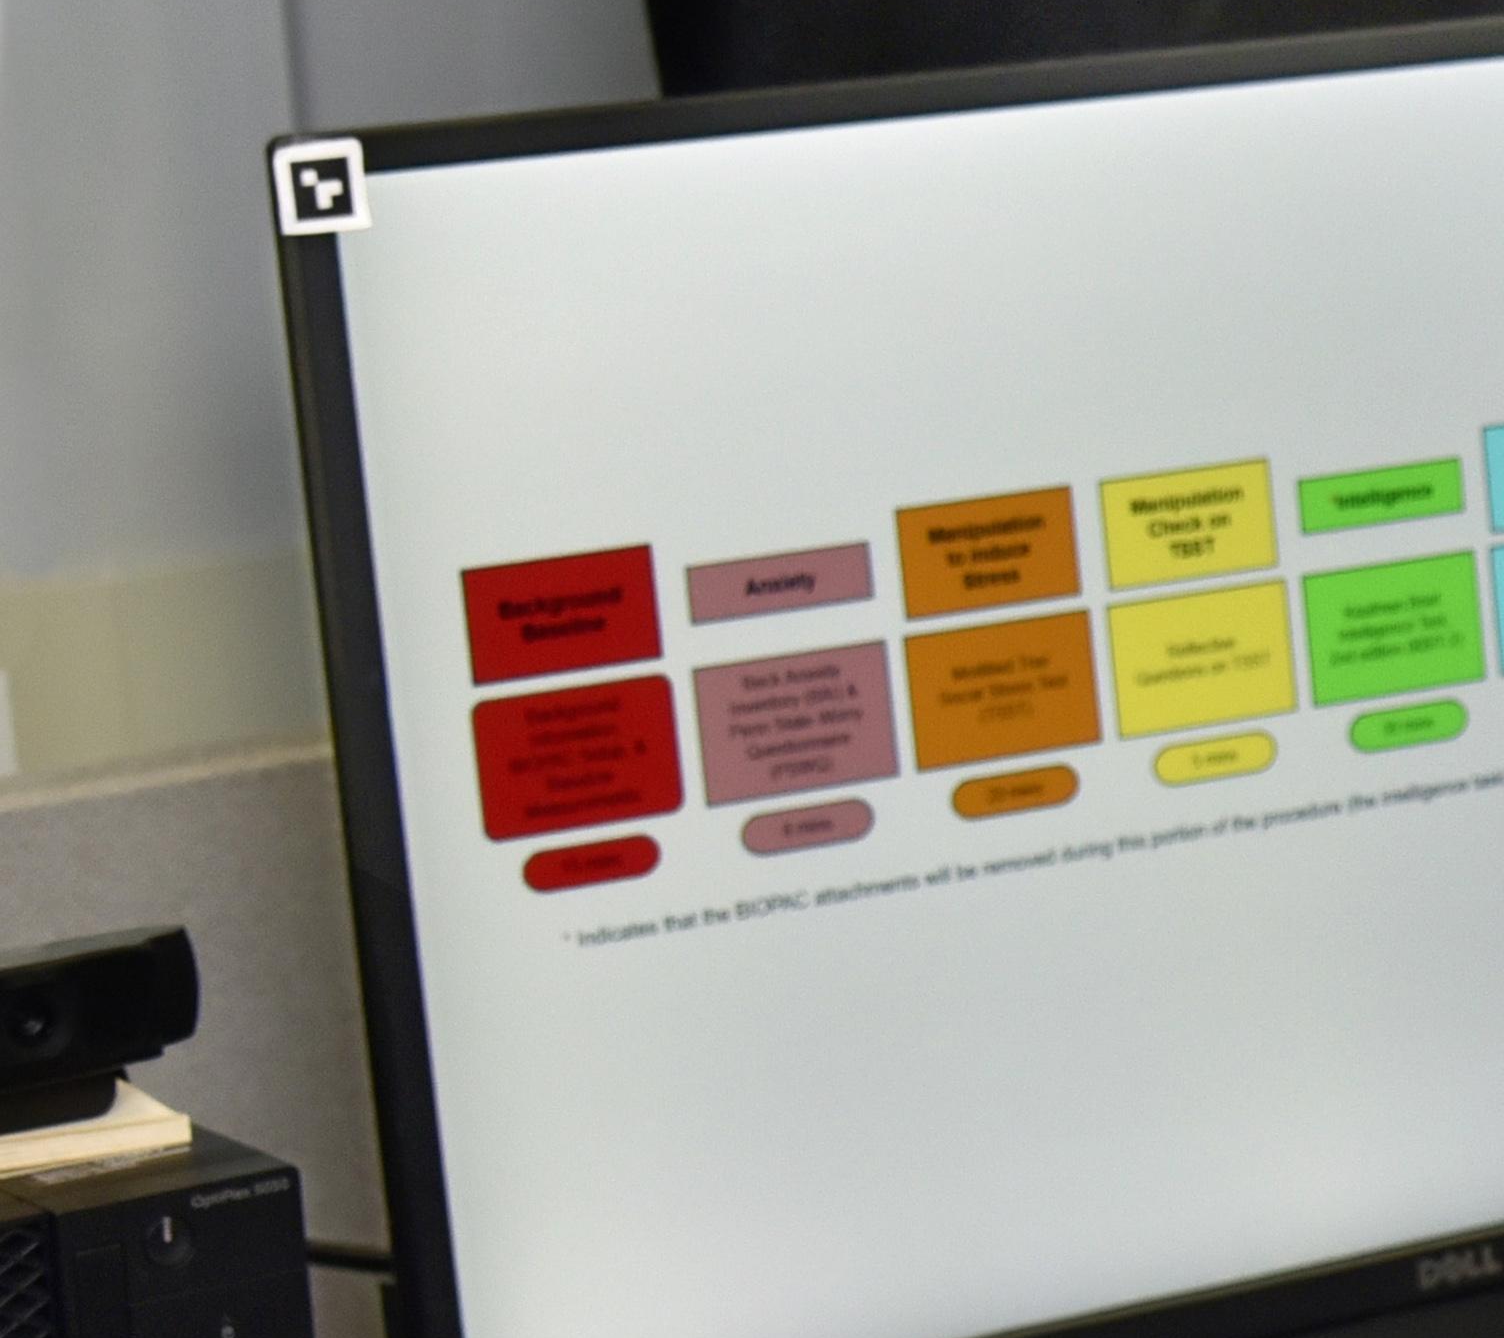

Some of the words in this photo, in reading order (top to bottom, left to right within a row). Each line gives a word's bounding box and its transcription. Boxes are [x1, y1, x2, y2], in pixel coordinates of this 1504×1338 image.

[1129, 486, 1243, 516] Manipulation
[927, 515, 1044, 544] Manipulation
[1147, 515, 1201, 538] Check
[1206, 510, 1232, 530] on
[745, 572, 817, 598] Anxiety
[964, 569, 1020, 590] Stress
[498, 586, 623, 619] Background
[728, 694, 801, 717] Inventory
[577, 919, 657, 948] Indicates
[662, 911, 697, 932] that
[701, 907, 731, 926] the
[734, 888, 810, 922] BIOPAC
[815, 873, 921, 907] attachments
[924, 863, 952, 886] will
[955, 861, 978, 881] be
[982, 848, 1057, 875] removed
[1060, 841, 1115, 867] during
[1116, 833, 1146, 854] this
[1150, 824, 1206, 852] portion
[1211, 816, 1231, 837] of
[1231, 813, 1256, 832] the
[1261, 799, 1342, 831] procedure
[1381, 778, 1470, 806] intelligence
